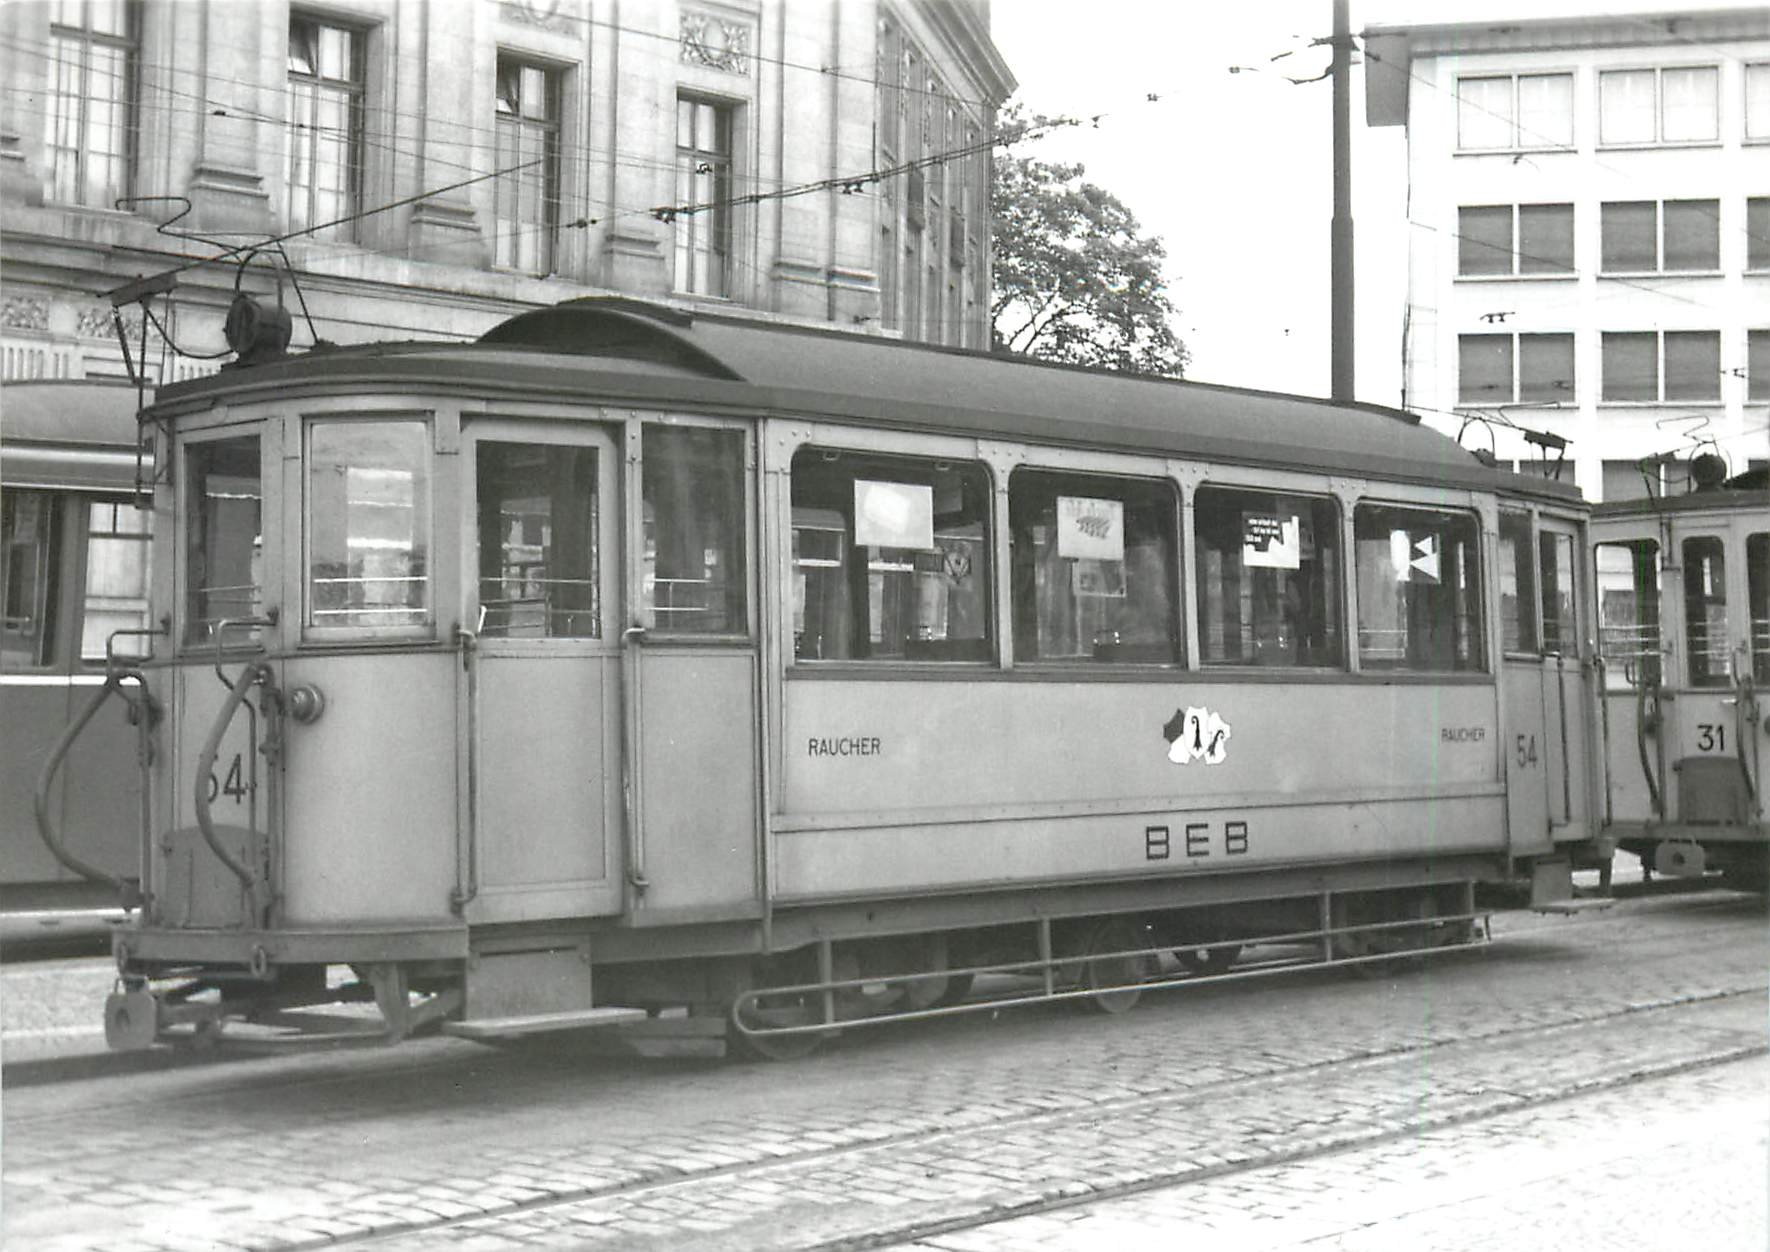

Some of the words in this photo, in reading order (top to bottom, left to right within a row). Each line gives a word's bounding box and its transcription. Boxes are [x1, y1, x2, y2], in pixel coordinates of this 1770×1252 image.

[808, 737, 881, 756] RAUCHER
[1441, 728, 1485, 743] RAUCHER
[1697, 724, 1724, 752] 31
[1517, 733, 1537, 768] 54
[1146, 821, 1248, 860] BEB
